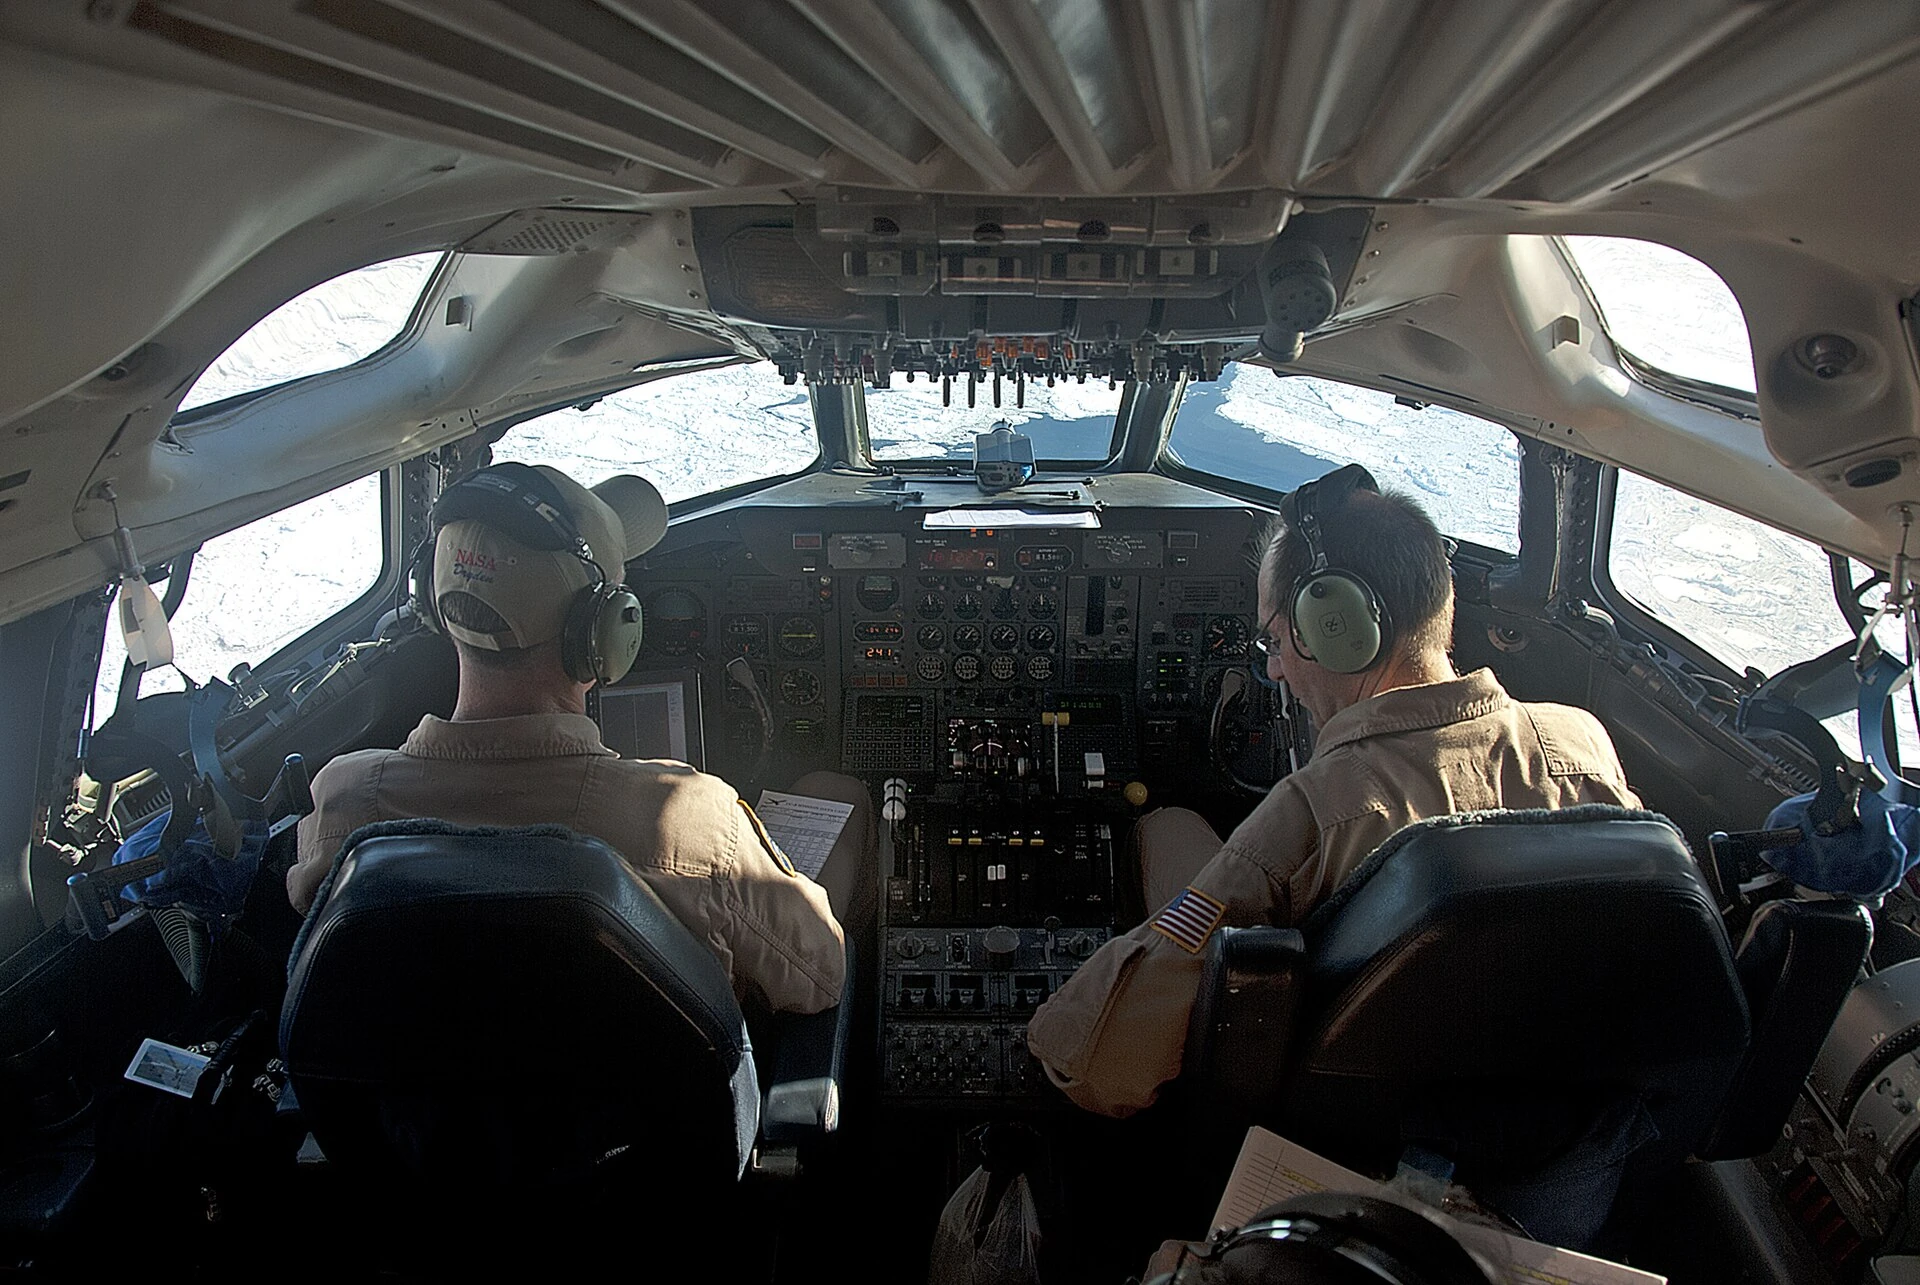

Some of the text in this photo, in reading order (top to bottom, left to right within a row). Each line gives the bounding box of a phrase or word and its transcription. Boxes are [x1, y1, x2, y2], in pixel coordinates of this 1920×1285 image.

[455, 548, 496, 571] NASA
[453, 563, 494, 584] Dryden
[866, 647, 892, 657] 241
